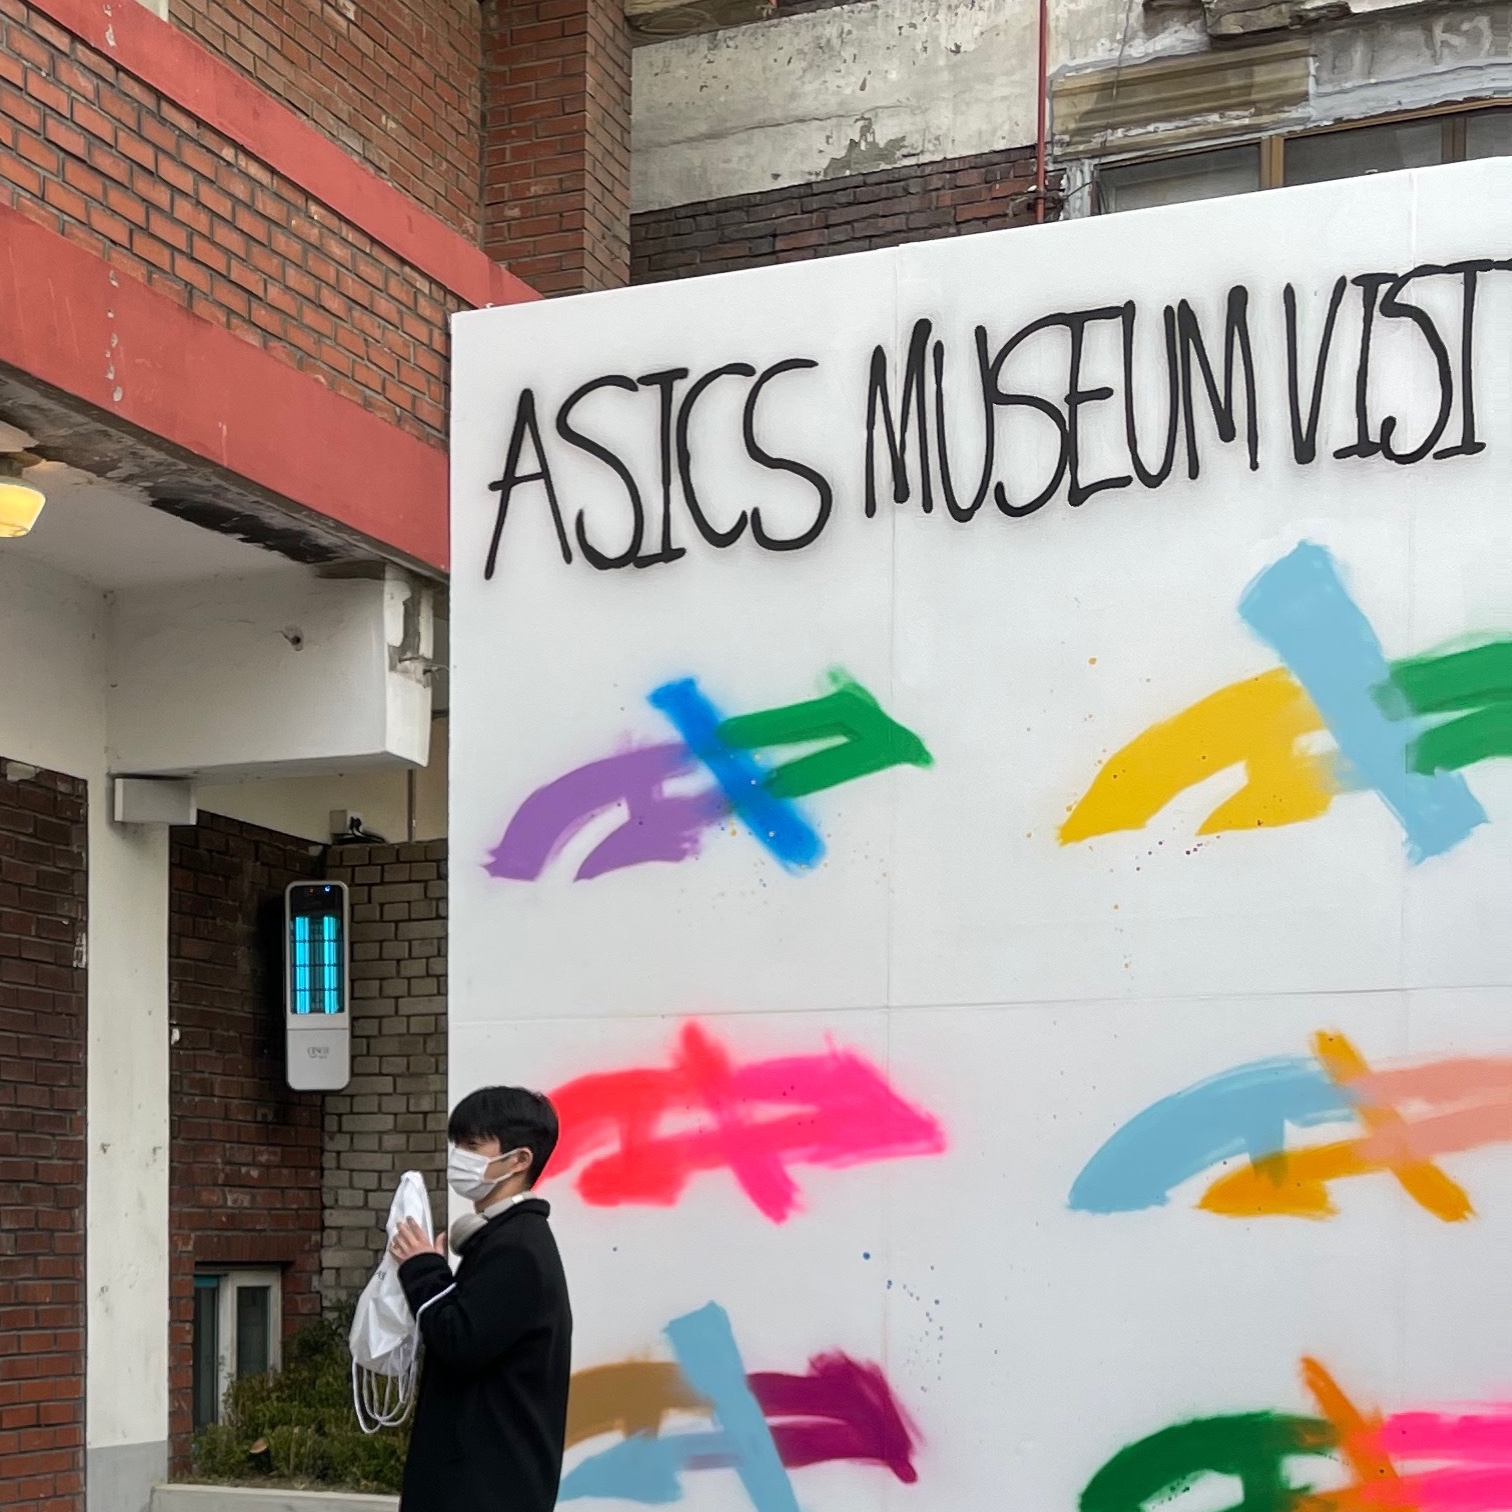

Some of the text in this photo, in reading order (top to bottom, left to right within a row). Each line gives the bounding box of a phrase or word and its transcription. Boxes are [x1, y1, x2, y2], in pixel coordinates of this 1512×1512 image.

[484, 258, 1512, 580] ASICS MUSEUM VISI
